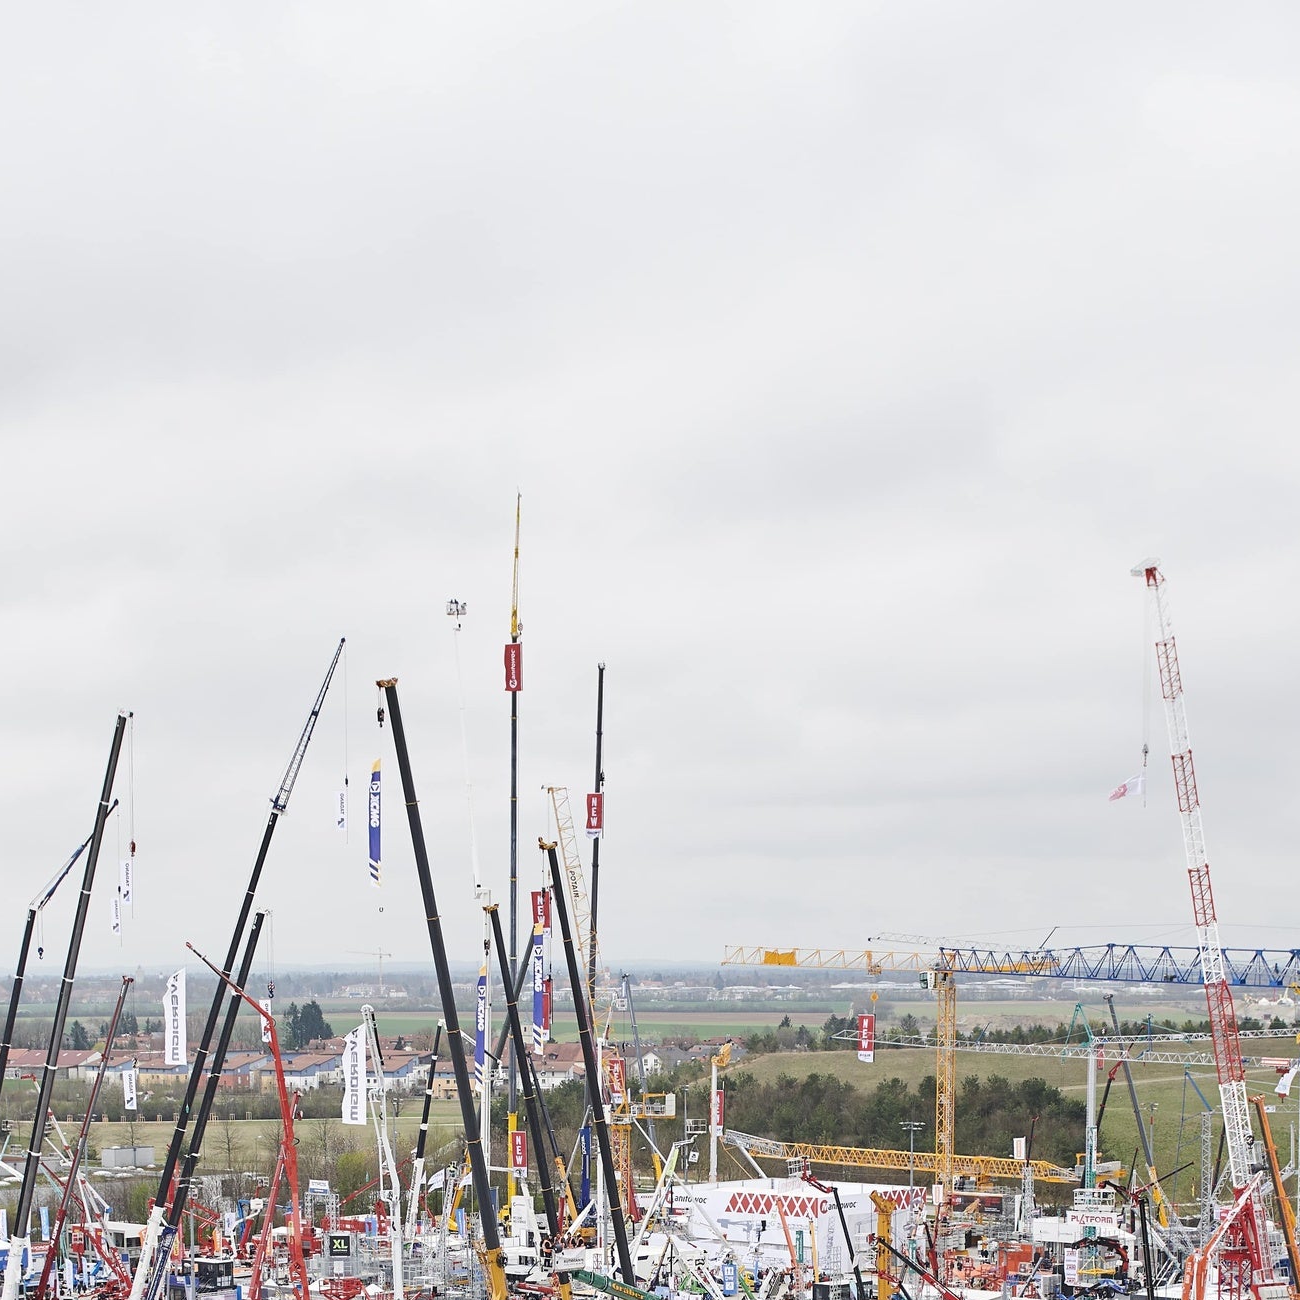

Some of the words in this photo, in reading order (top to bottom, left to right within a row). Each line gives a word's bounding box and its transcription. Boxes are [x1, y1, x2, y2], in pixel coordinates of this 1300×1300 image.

[509, 648, 518, 689] Manitowoc
[370, 792, 380, 828] XCMG
[590, 797, 599, 827] NEW
[515, 1135, 523, 1165] NEW
[1071, 1214, 1113, 1225] PLATFORM
[332, 1239, 348, 1249] XL
